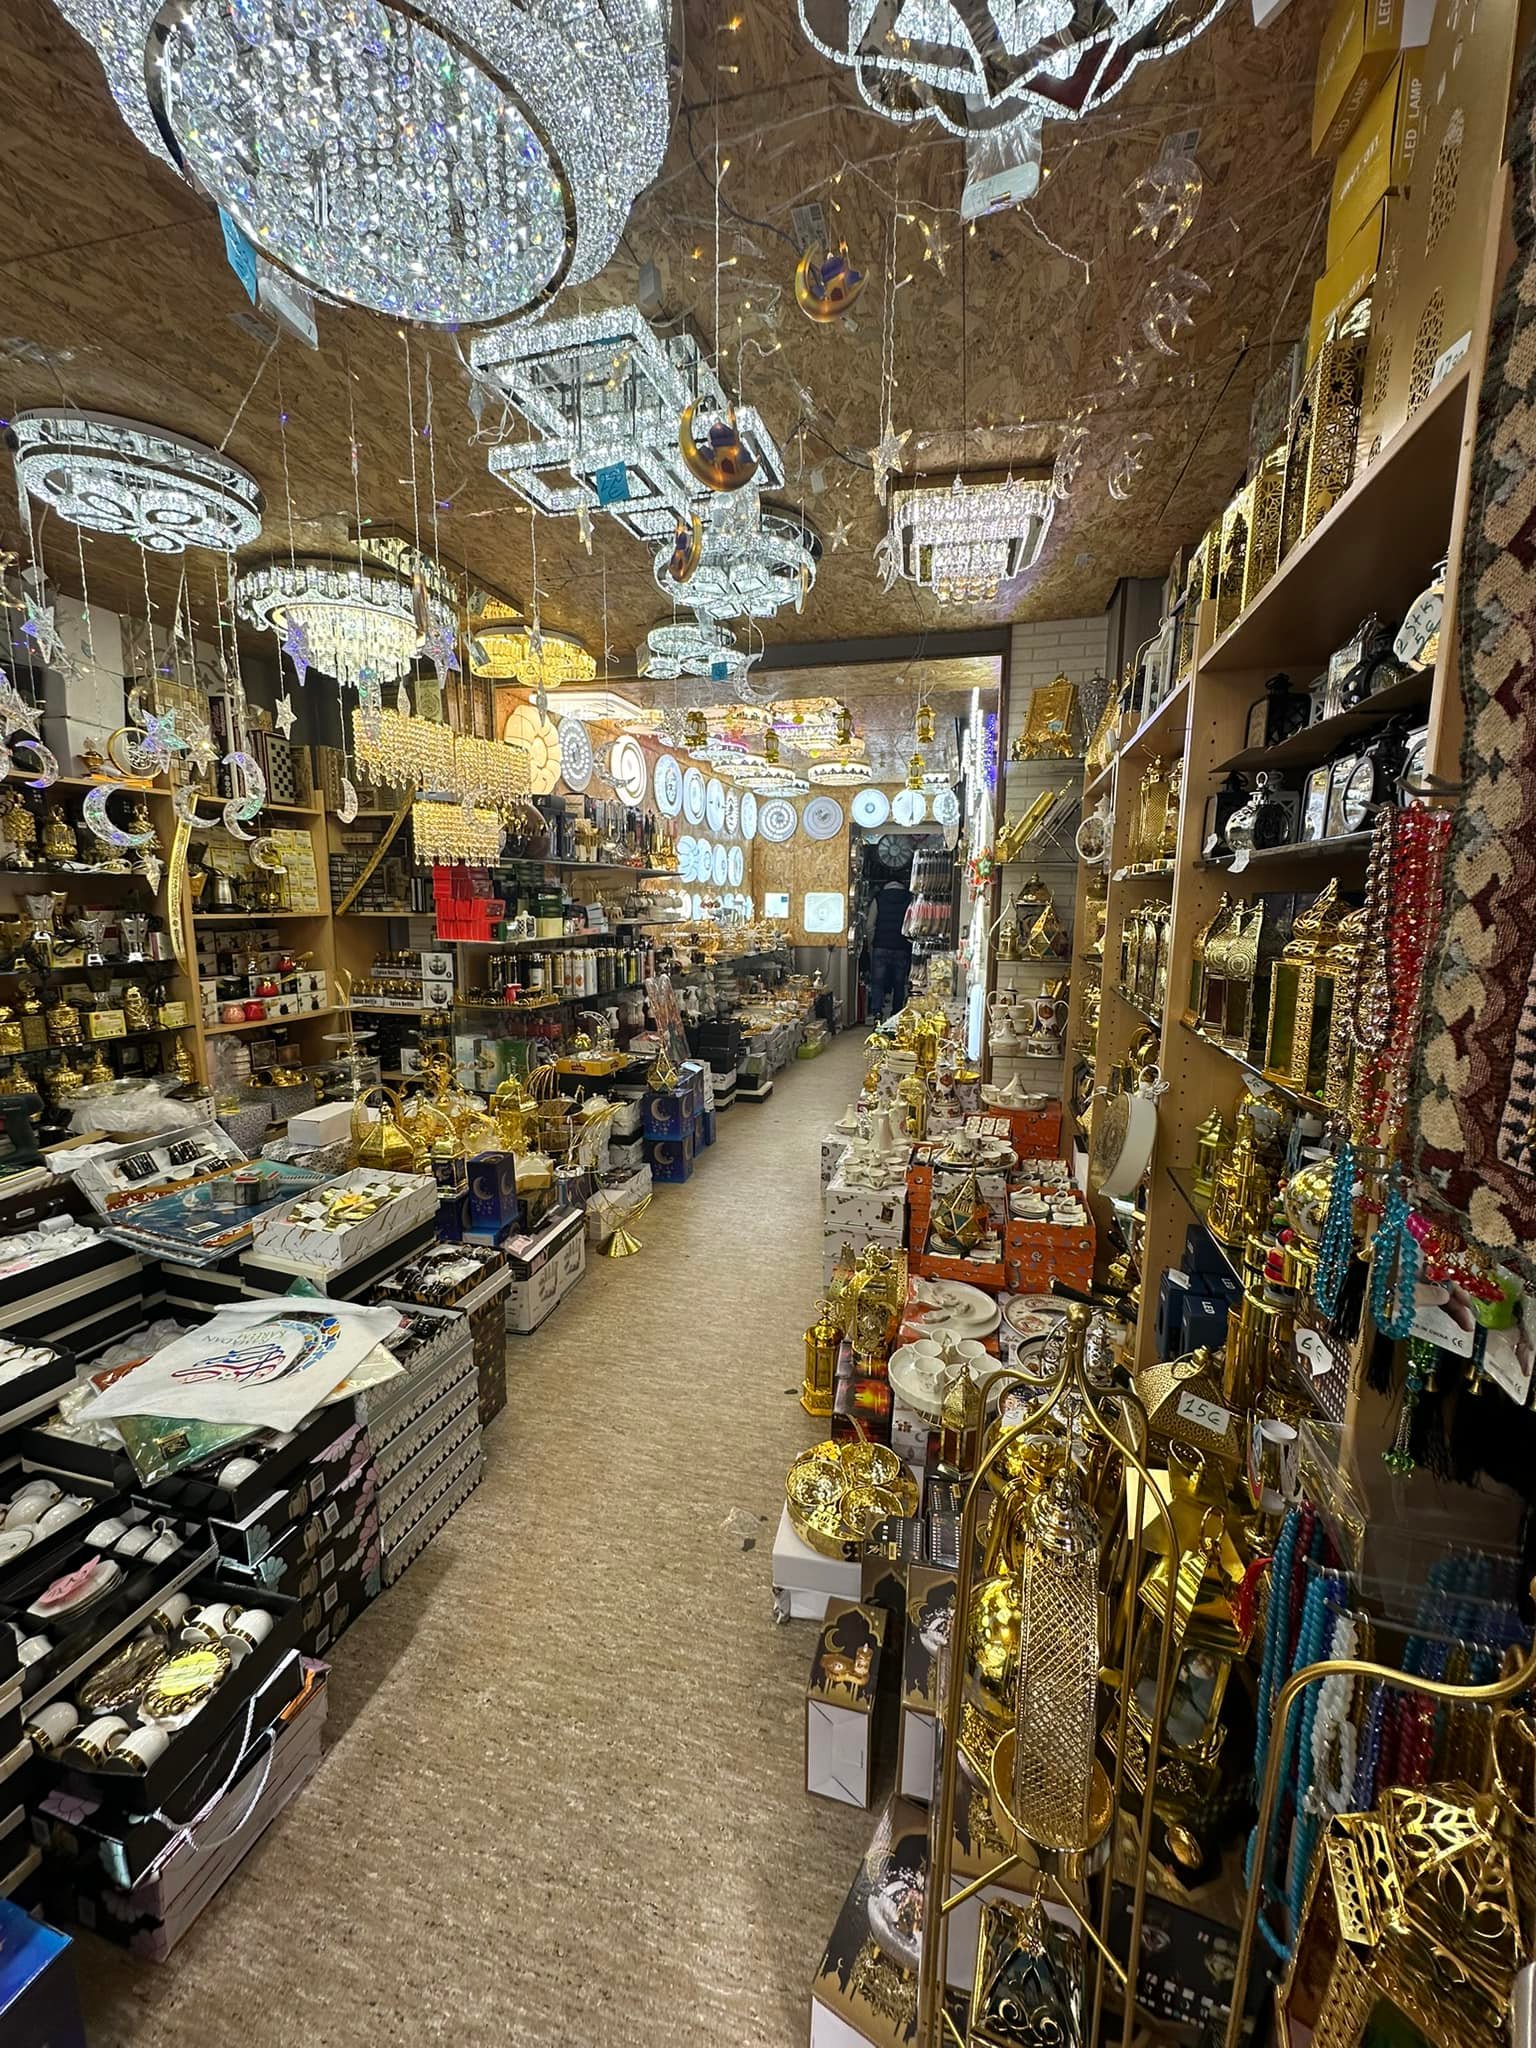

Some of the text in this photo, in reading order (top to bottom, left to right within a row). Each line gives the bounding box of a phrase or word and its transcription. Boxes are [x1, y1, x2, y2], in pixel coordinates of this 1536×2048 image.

[1332, 78, 1368, 141] LED LAMP
[1408, 78, 1422, 118] LAMP
[1395, 638, 1409, 655] 2
[237, 1329, 287, 1342] KAREEM
[1183, 1398, 1220, 1426] 15€
